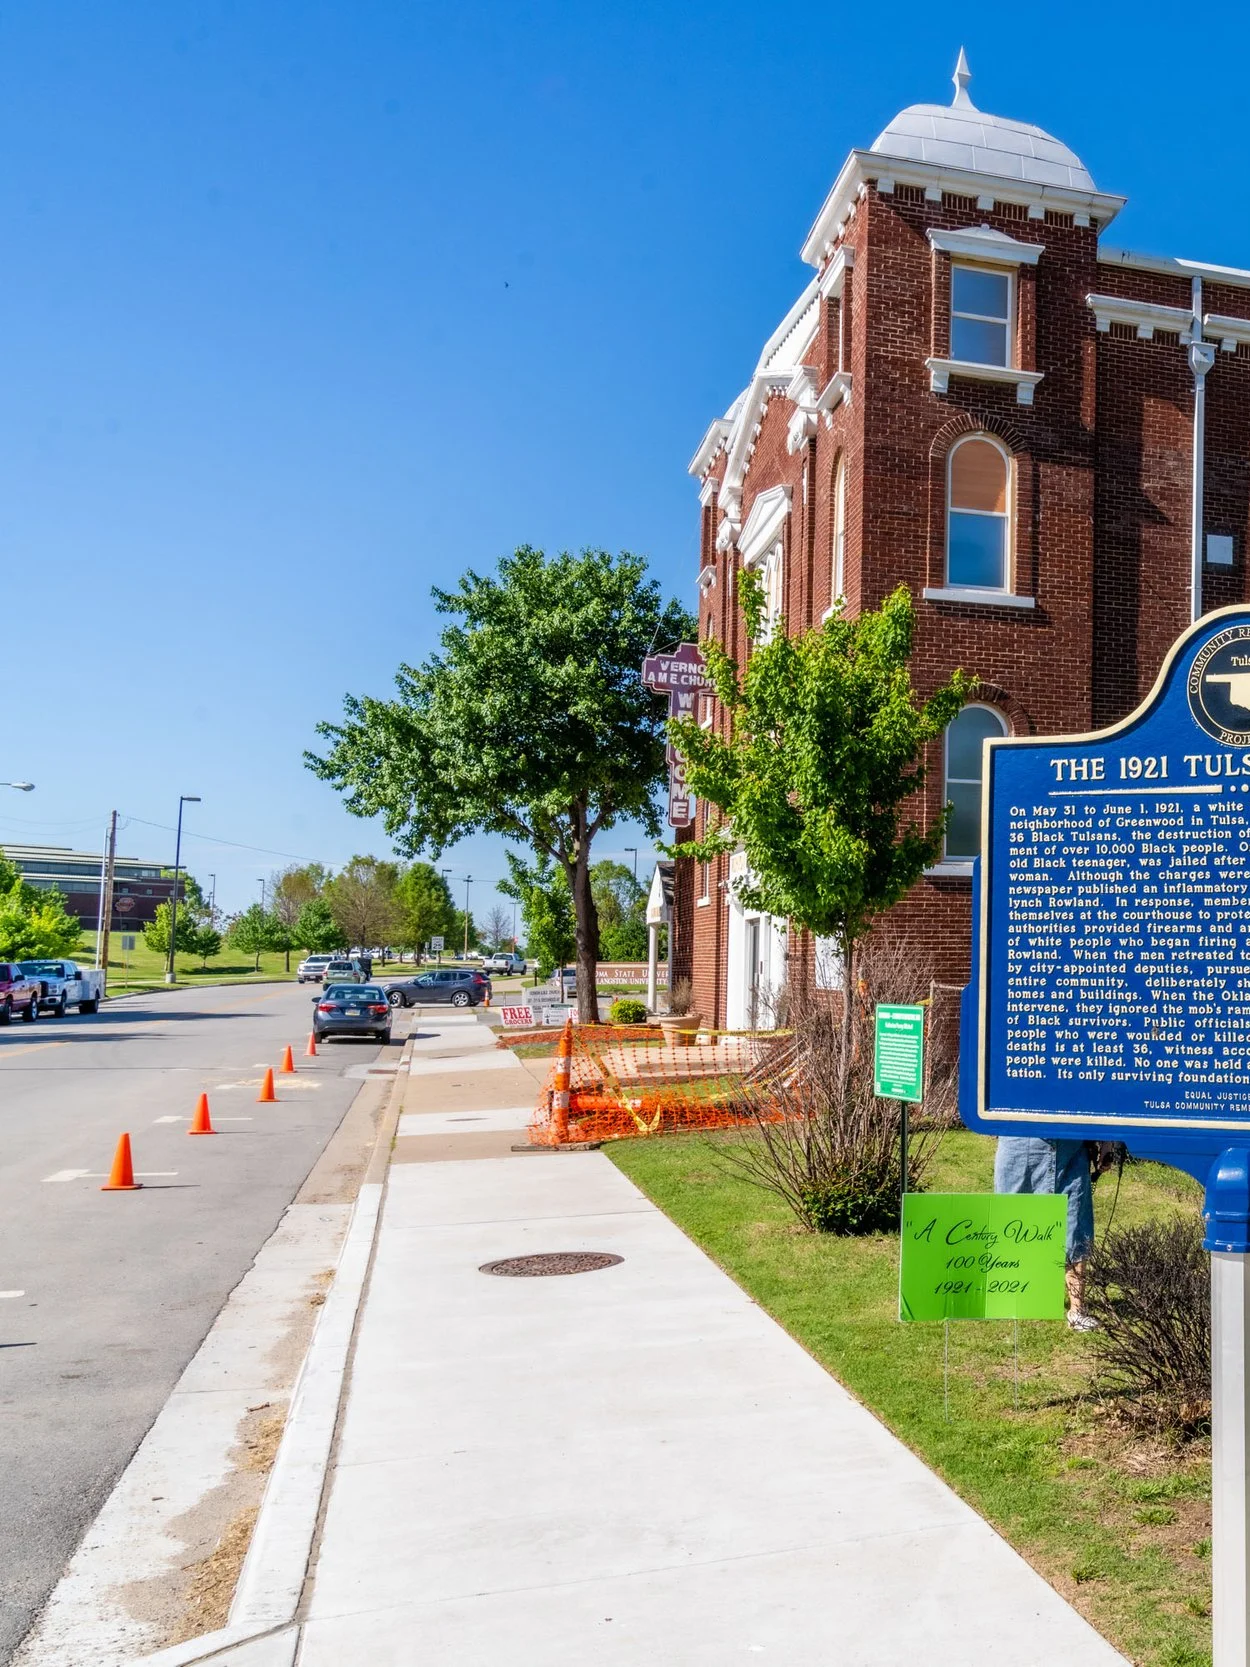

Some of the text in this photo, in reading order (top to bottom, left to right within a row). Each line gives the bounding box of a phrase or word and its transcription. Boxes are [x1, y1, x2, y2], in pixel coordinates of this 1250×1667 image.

[660, 660, 707, 675] VERNO
[1190, 630, 1235, 694] COMMUNITY
[1050, 758, 1106, 781] THE
[1119, 756, 1168, 779] 1921
[1009, 832, 1024, 842] 36
[1031, 831, 1064, 842] Black
[1070, 831, 1120, 841] Tulsans,
[1131, 830, 1151, 840] the
[1157, 828, 1232, 839] destruction
[1238, 827, 1250, 838] of
[1009, 858, 1028, 868] old
[1033, 857, 1066, 868] Black
[1071, 857, 1130, 869] teenager,
[1138, 858, 1161, 866] was
[1168, 855, 1207, 868] jailed
[1214, 855, 1246, 865] after
[1008, 885, 1072, 896] newspaper
[1077, 883, 1136, 896] published
[1143, 885, 1158, 893] an
[1163, 882, 1248, 893] inflammatory
[1008, 910, 1074, 920] themselves
[1080, 910, 1092, 920] at
[1096, 910, 1117, 920] the
[1122, 910, 1192, 919] courthouse
[1198, 910, 1210, 919] to
[1007, 936, 1020, 946] of
[1028, 936, 1062, 946] white
[1069, 935, 1111, 948] people
[1118, 936, 1144, 946] who
[1150, 936, 1190, 949] began
[1198, 936, 1236, 949] firing
[1007, 962, 1022, 974] by
[1029, 962, 1126, 975] city-appointed
[1134, 963, 1193, 975] deputies,
[1007, 988, 1044, 998] homes
[1050, 989, 1072, 999] and
[1080, 989, 1142, 1002] buildings.
[1150, 989, 1186, 1000] When
[1192, 990, 1214, 1000] the
[502, 1007, 532, 1019] FREE
[1006, 1014, 1019, 1024] of
[1028, 1014, 1060, 1025] Black
[1068, 1015, 1131, 1026] survivors.
[1144, 1017, 1185, 1027] Public
[1194, 1017, 1250, 1028] officials
[1006, 1041, 1046, 1051] deaths
[1055, 1042, 1065, 1052] is
[1072, 1043, 1084, 1052] at
[1092, 1042, 1124, 1053] least
[1132, 1043, 1152, 1054] 36,
[1164, 1044, 1213, 1055] witness
[1006, 1067, 1046, 1078] tation.
[1057, 1068, 1072, 1078] Its
[1078, 1069, 1105, 1081] only
[1111, 1071, 1172, 1084] surviving
[1178, 1071, 1250, 1084] foundation
[1185, 1091, 1212, 1099] EQUAL
[1144, 1101, 1171, 1109] TULSA
[1175, 1102, 1225, 1111] COMMUNITY
[946, 1219, 999, 1249] Century
[946, 1253, 1020, 1273] 100 Years
[934, 1281, 973, 1294] 1921
[987, 1280, 1030, 1294] 2021
